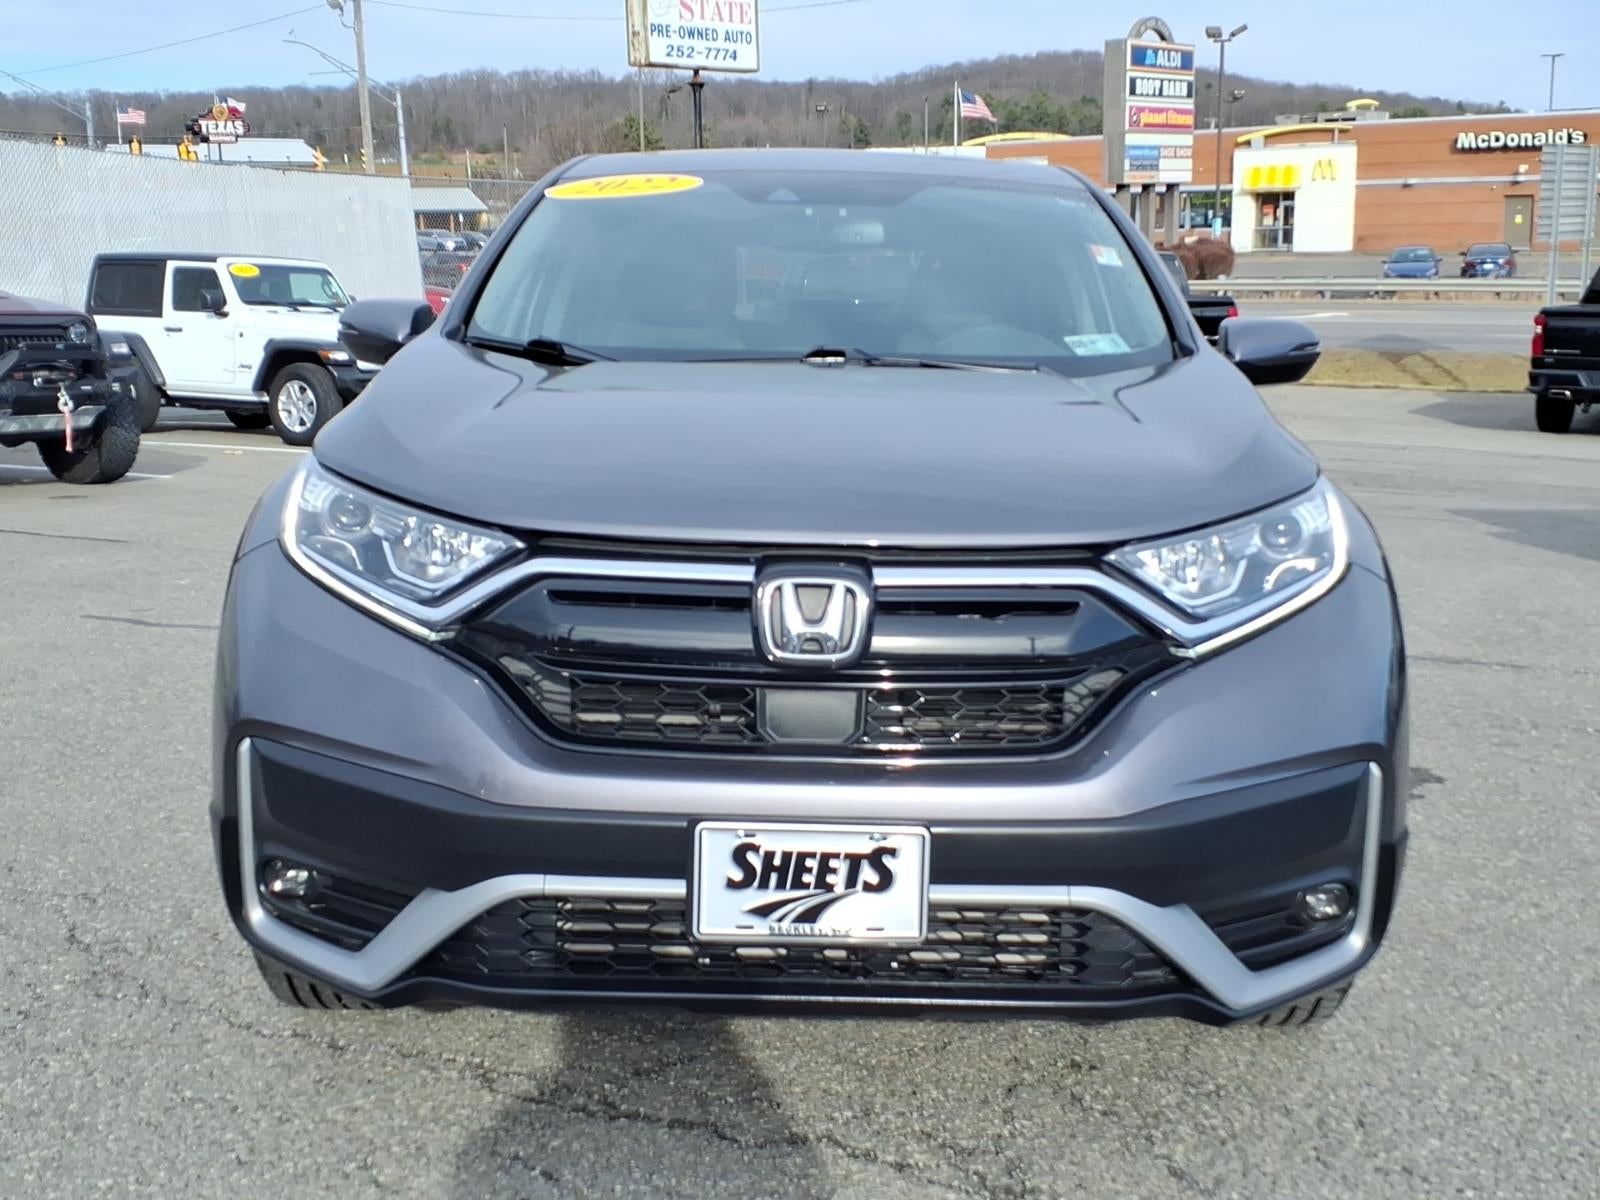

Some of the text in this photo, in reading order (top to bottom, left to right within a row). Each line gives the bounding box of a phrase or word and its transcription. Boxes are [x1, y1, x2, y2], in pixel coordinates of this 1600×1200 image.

[678, 0, 752, 24] STATE
[650, 23, 752, 45] PRE-OWNED AUTO
[665, 44, 738, 61] 252-7774
[1156, 49, 1182, 69] ALDI
[1135, 78, 1161, 96] BOOT
[198, 119, 245, 136] TEXAS
[1456, 128, 1585, 150] McDonald's
[726, 842, 900, 893] SHEETS
